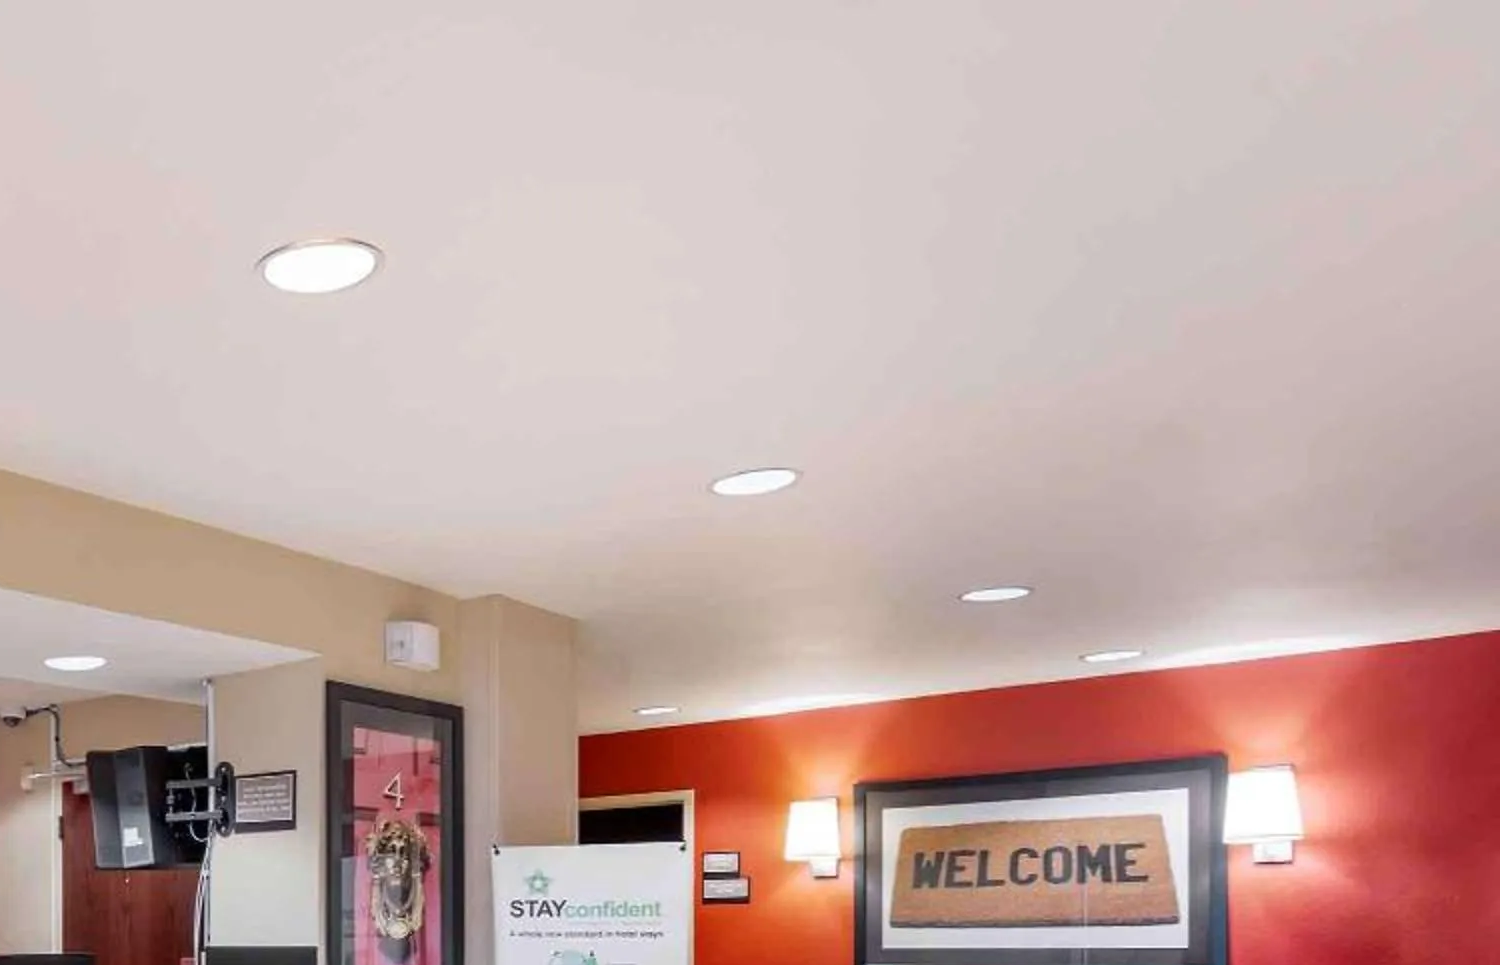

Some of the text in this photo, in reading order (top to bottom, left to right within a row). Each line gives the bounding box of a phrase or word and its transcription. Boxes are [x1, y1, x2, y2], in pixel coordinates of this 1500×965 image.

[383, 770, 405, 811] 4
[911, 843, 1150, 890] WELCOME
[509, 899, 662, 918] STAYconfident
